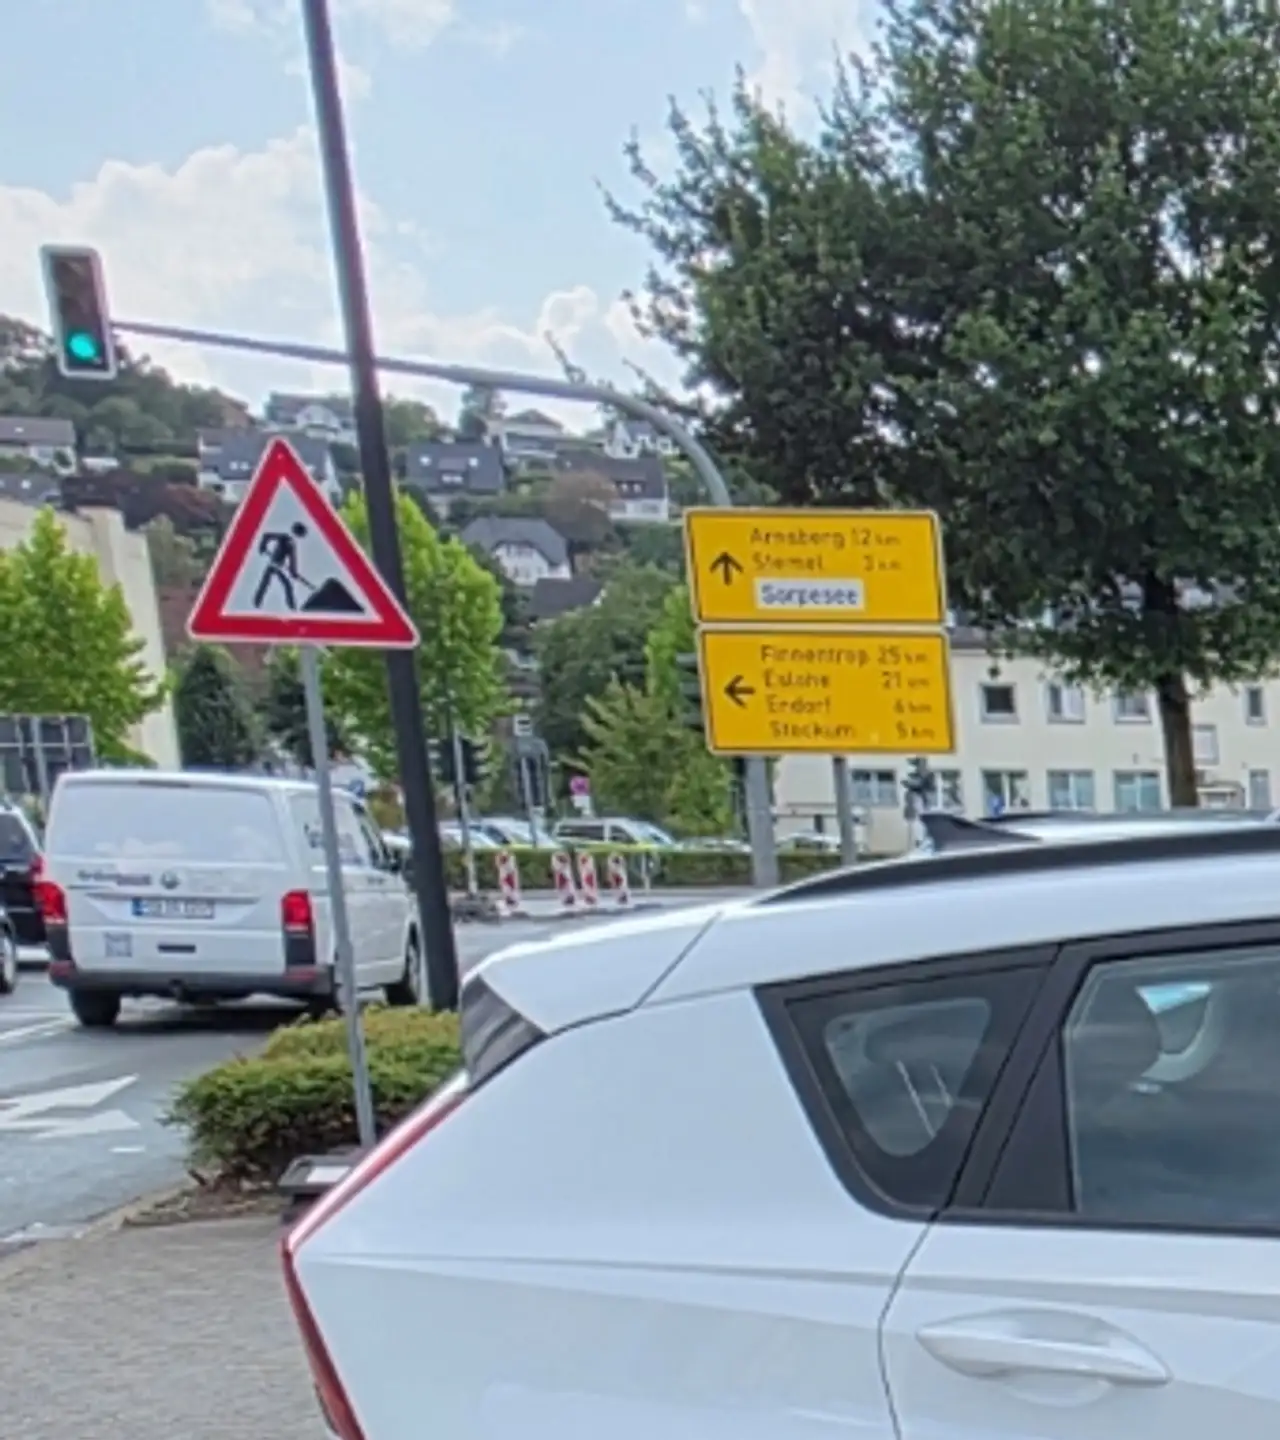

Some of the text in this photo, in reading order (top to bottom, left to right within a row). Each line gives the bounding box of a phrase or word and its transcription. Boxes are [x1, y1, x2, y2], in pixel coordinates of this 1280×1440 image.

[750, 527, 845, 550] Arnsberg
[852, 527, 871, 546] 12
[752, 552, 823, 571] Stemel
[761, 584, 858, 608] Sorpesee
[761, 644, 870, 668] Finnentrop
